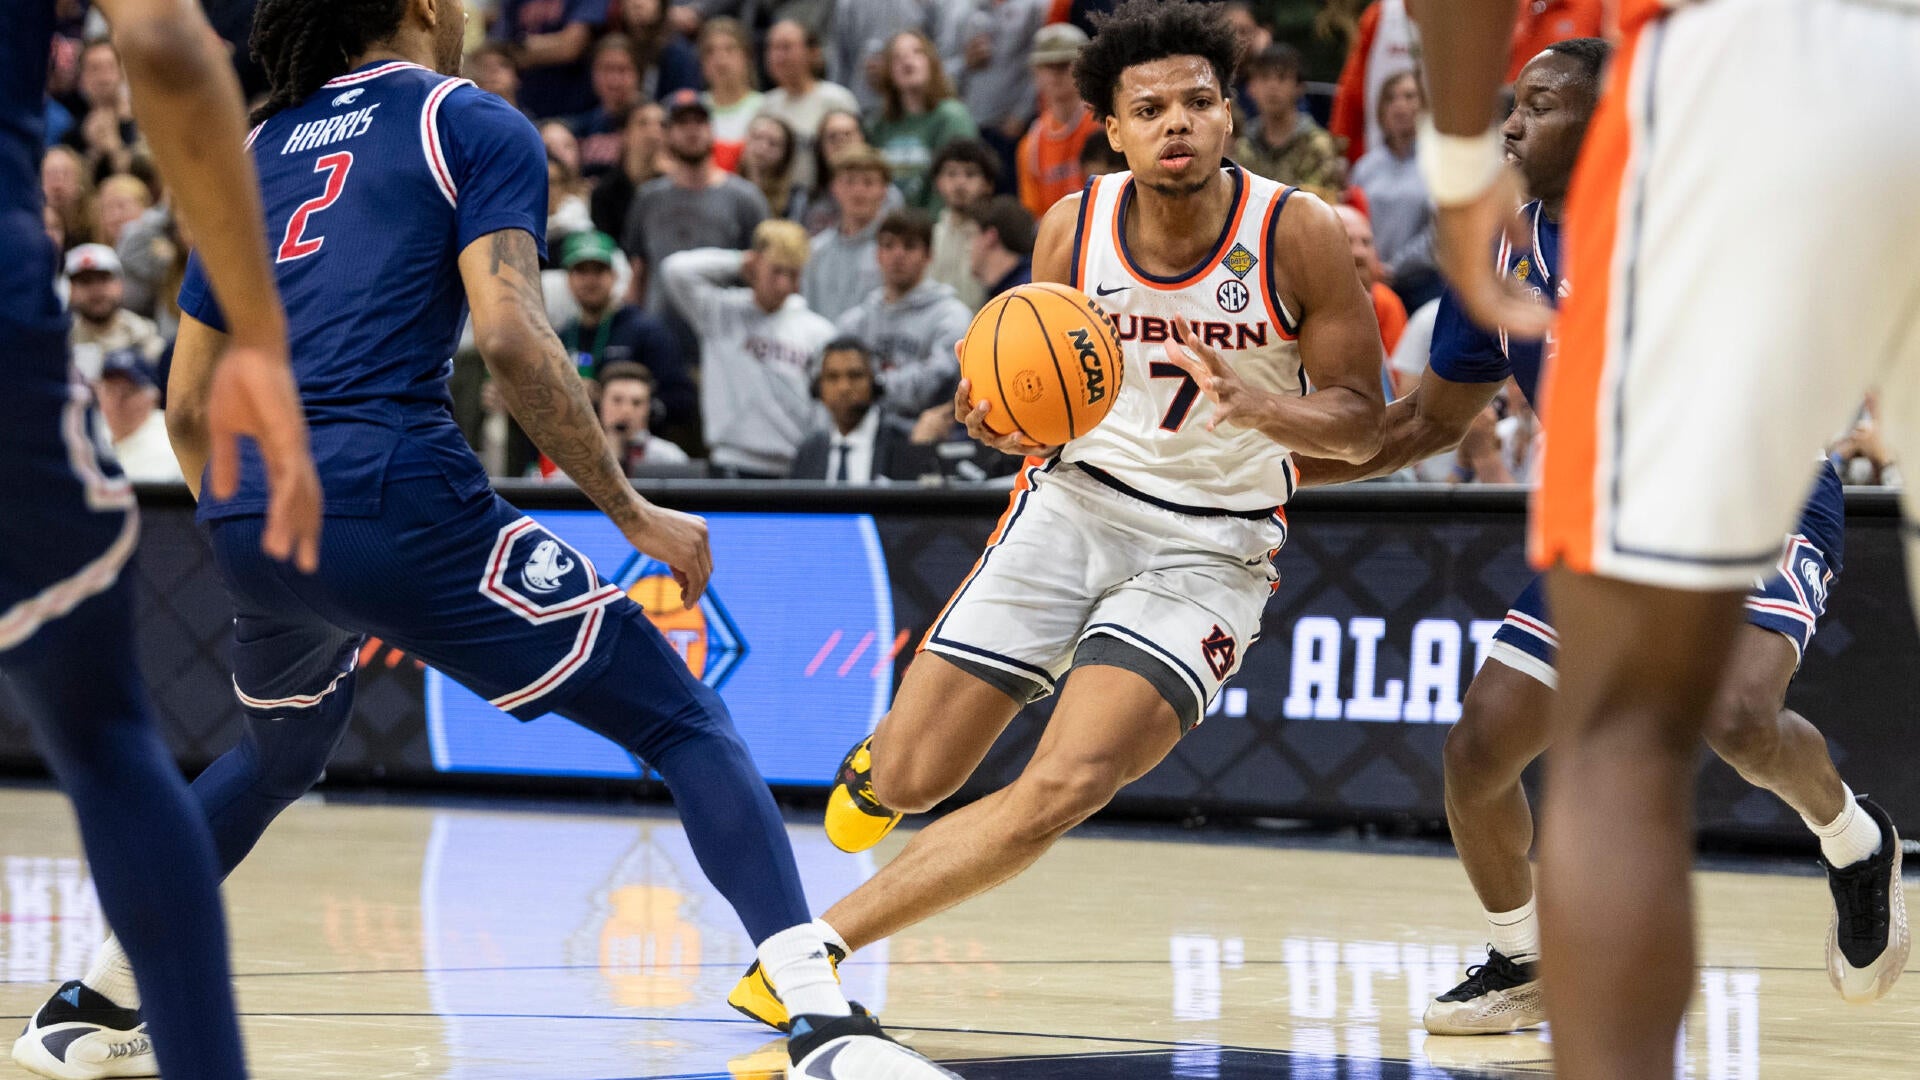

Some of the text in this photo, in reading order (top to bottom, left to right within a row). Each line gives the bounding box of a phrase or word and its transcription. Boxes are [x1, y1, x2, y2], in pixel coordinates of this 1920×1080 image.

[281, 102, 381, 155] HARRIS
[275, 150, 354, 264] 2
[1218, 281, 1248, 312] SEC
[1109, 312, 1268, 351] UBURN
[1067, 328, 1106, 405] NCAA
[1149, 361, 1200, 433] 7
